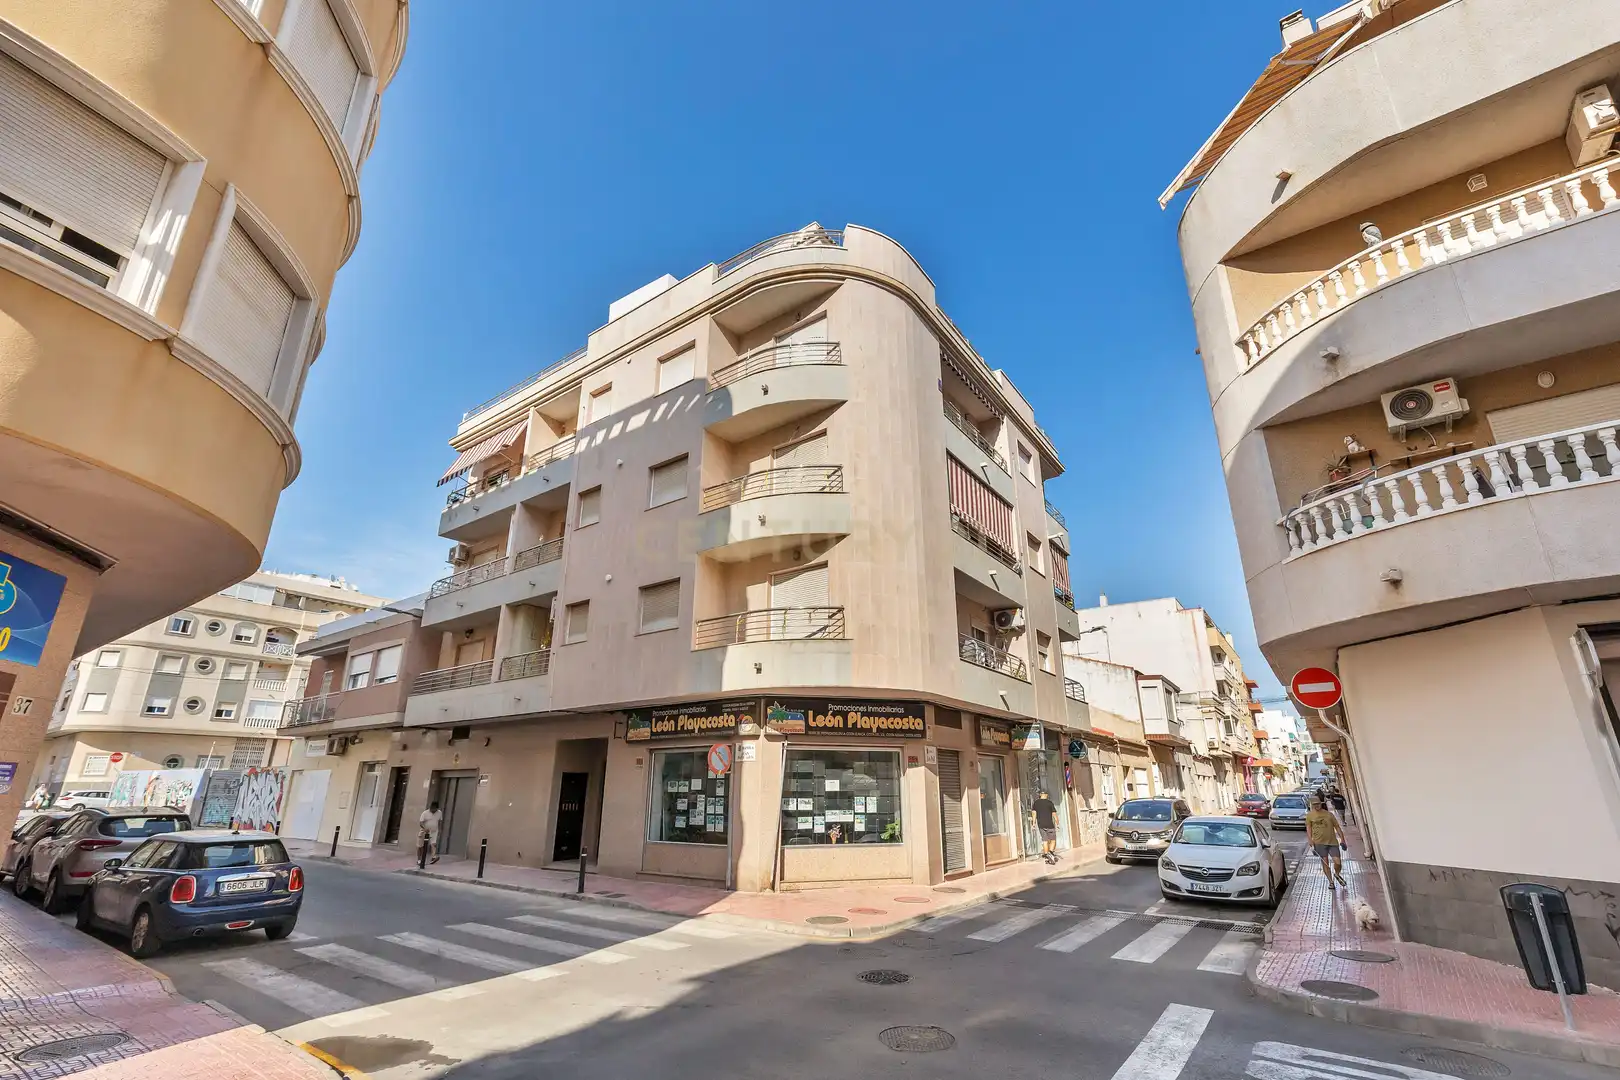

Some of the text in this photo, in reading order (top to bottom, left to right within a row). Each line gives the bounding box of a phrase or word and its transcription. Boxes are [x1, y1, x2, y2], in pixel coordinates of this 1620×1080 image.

[13, 697, 32, 715] 37
[828, 703, 904, 714] Promociones Inmobiliarias
[652, 713, 736, 734] León Playacosta
[808, 710, 924, 733] León Playacosta
